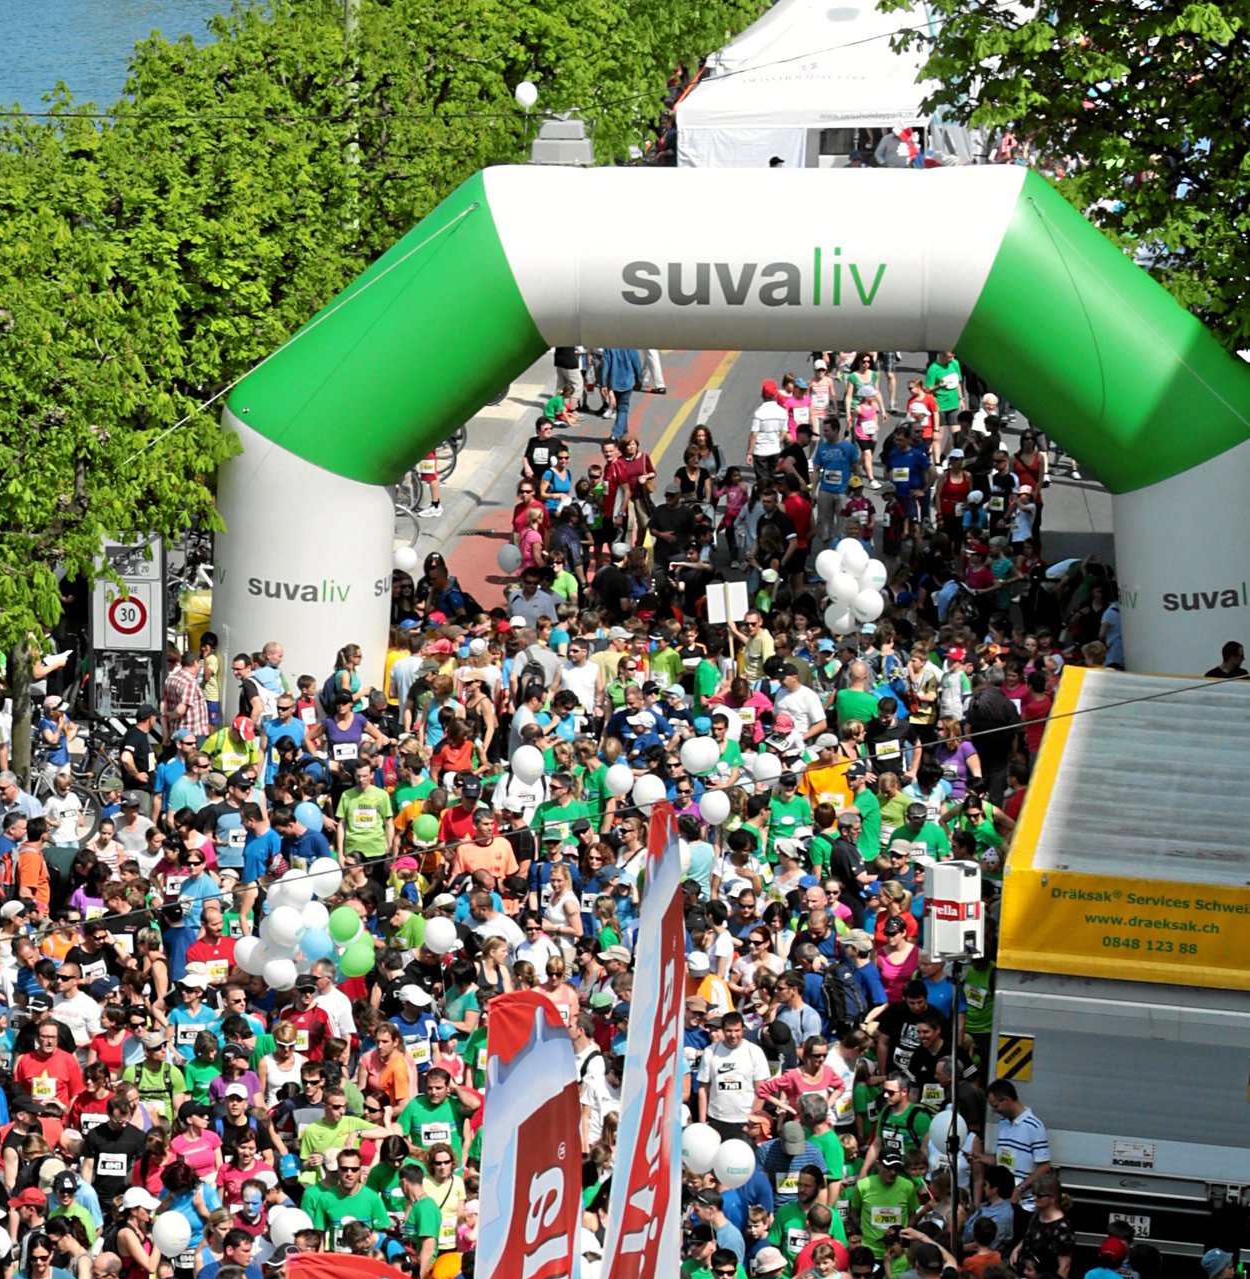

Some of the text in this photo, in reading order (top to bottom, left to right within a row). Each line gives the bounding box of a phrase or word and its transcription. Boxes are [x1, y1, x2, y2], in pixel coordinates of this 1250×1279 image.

[120, 608, 136, 622] 30
[1127, 893, 1190, 909] Services
[1085, 914, 1220, 934] www.draeksak.ch
[1102, 936, 1198, 954] 0848 123 88
